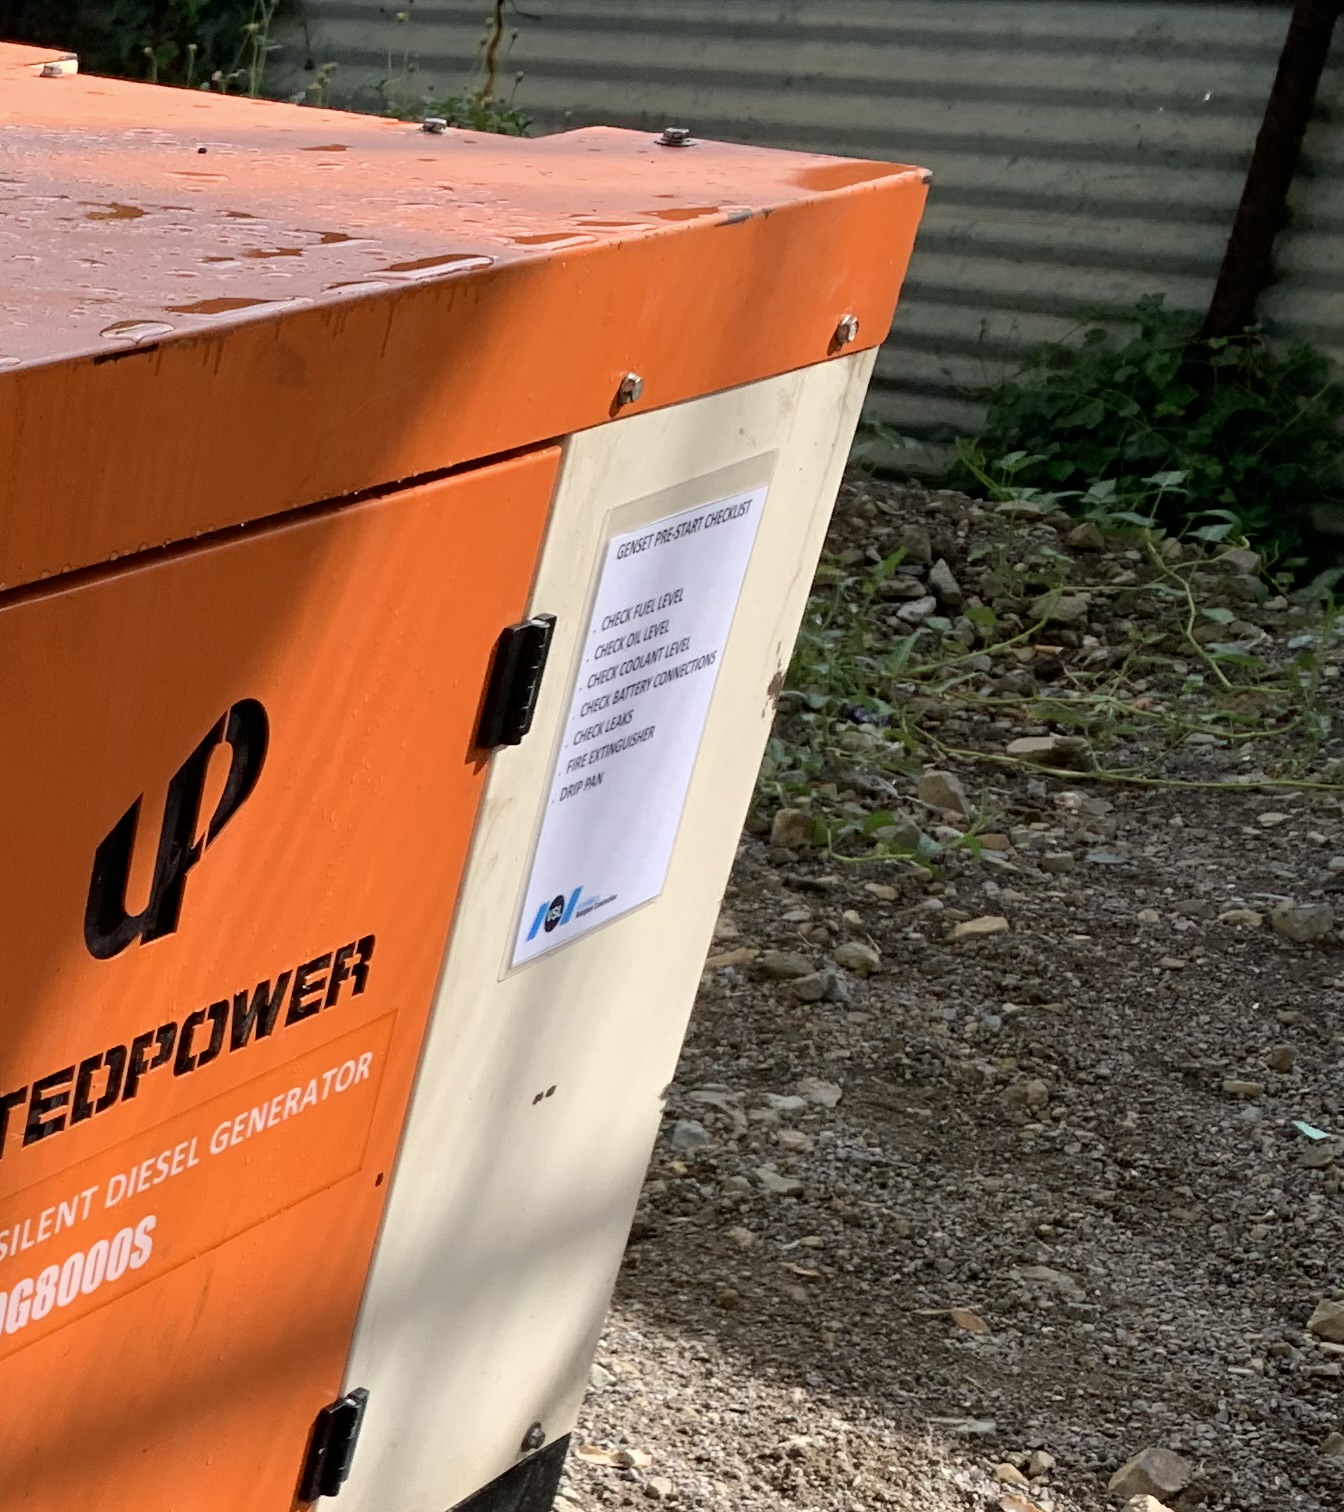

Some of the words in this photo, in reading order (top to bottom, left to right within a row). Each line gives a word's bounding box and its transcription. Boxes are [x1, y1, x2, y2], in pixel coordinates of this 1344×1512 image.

[616, 533, 655, 561] GENSET
[654, 516, 704, 547] PRE-START
[704, 499, 753, 529] CHECKLIST
[601, 606, 634, 632] CHECK
[633, 598, 656, 620] FUEL
[657, 587, 684, 611] LEVEL
[587, 664, 620, 689] CHECK
[619, 647, 665, 677] COOLANT
[664, 636, 691, 659] LEVEL
[594, 635, 627, 661] CHECK
[626, 630, 642, 648] OIL
[643, 619, 670, 641] LEVEL
[580, 693, 612, 718] CHECK
[612, 676, 654, 705] BATTERY
[653, 650, 718, 688] CONNECTIONS
[566, 753, 588, 774] FIRE
[588, 725, 656, 765] EXTINGUISHER
[573, 721, 605, 746] CHECK
[605, 709, 634, 733] LEAKS
[559, 780, 584, 802] DRIP
[584, 771, 605, 791] PAN
[105, 1135, 200, 1207] DIESEL
[209, 1050, 374, 1155] GENERATOR
